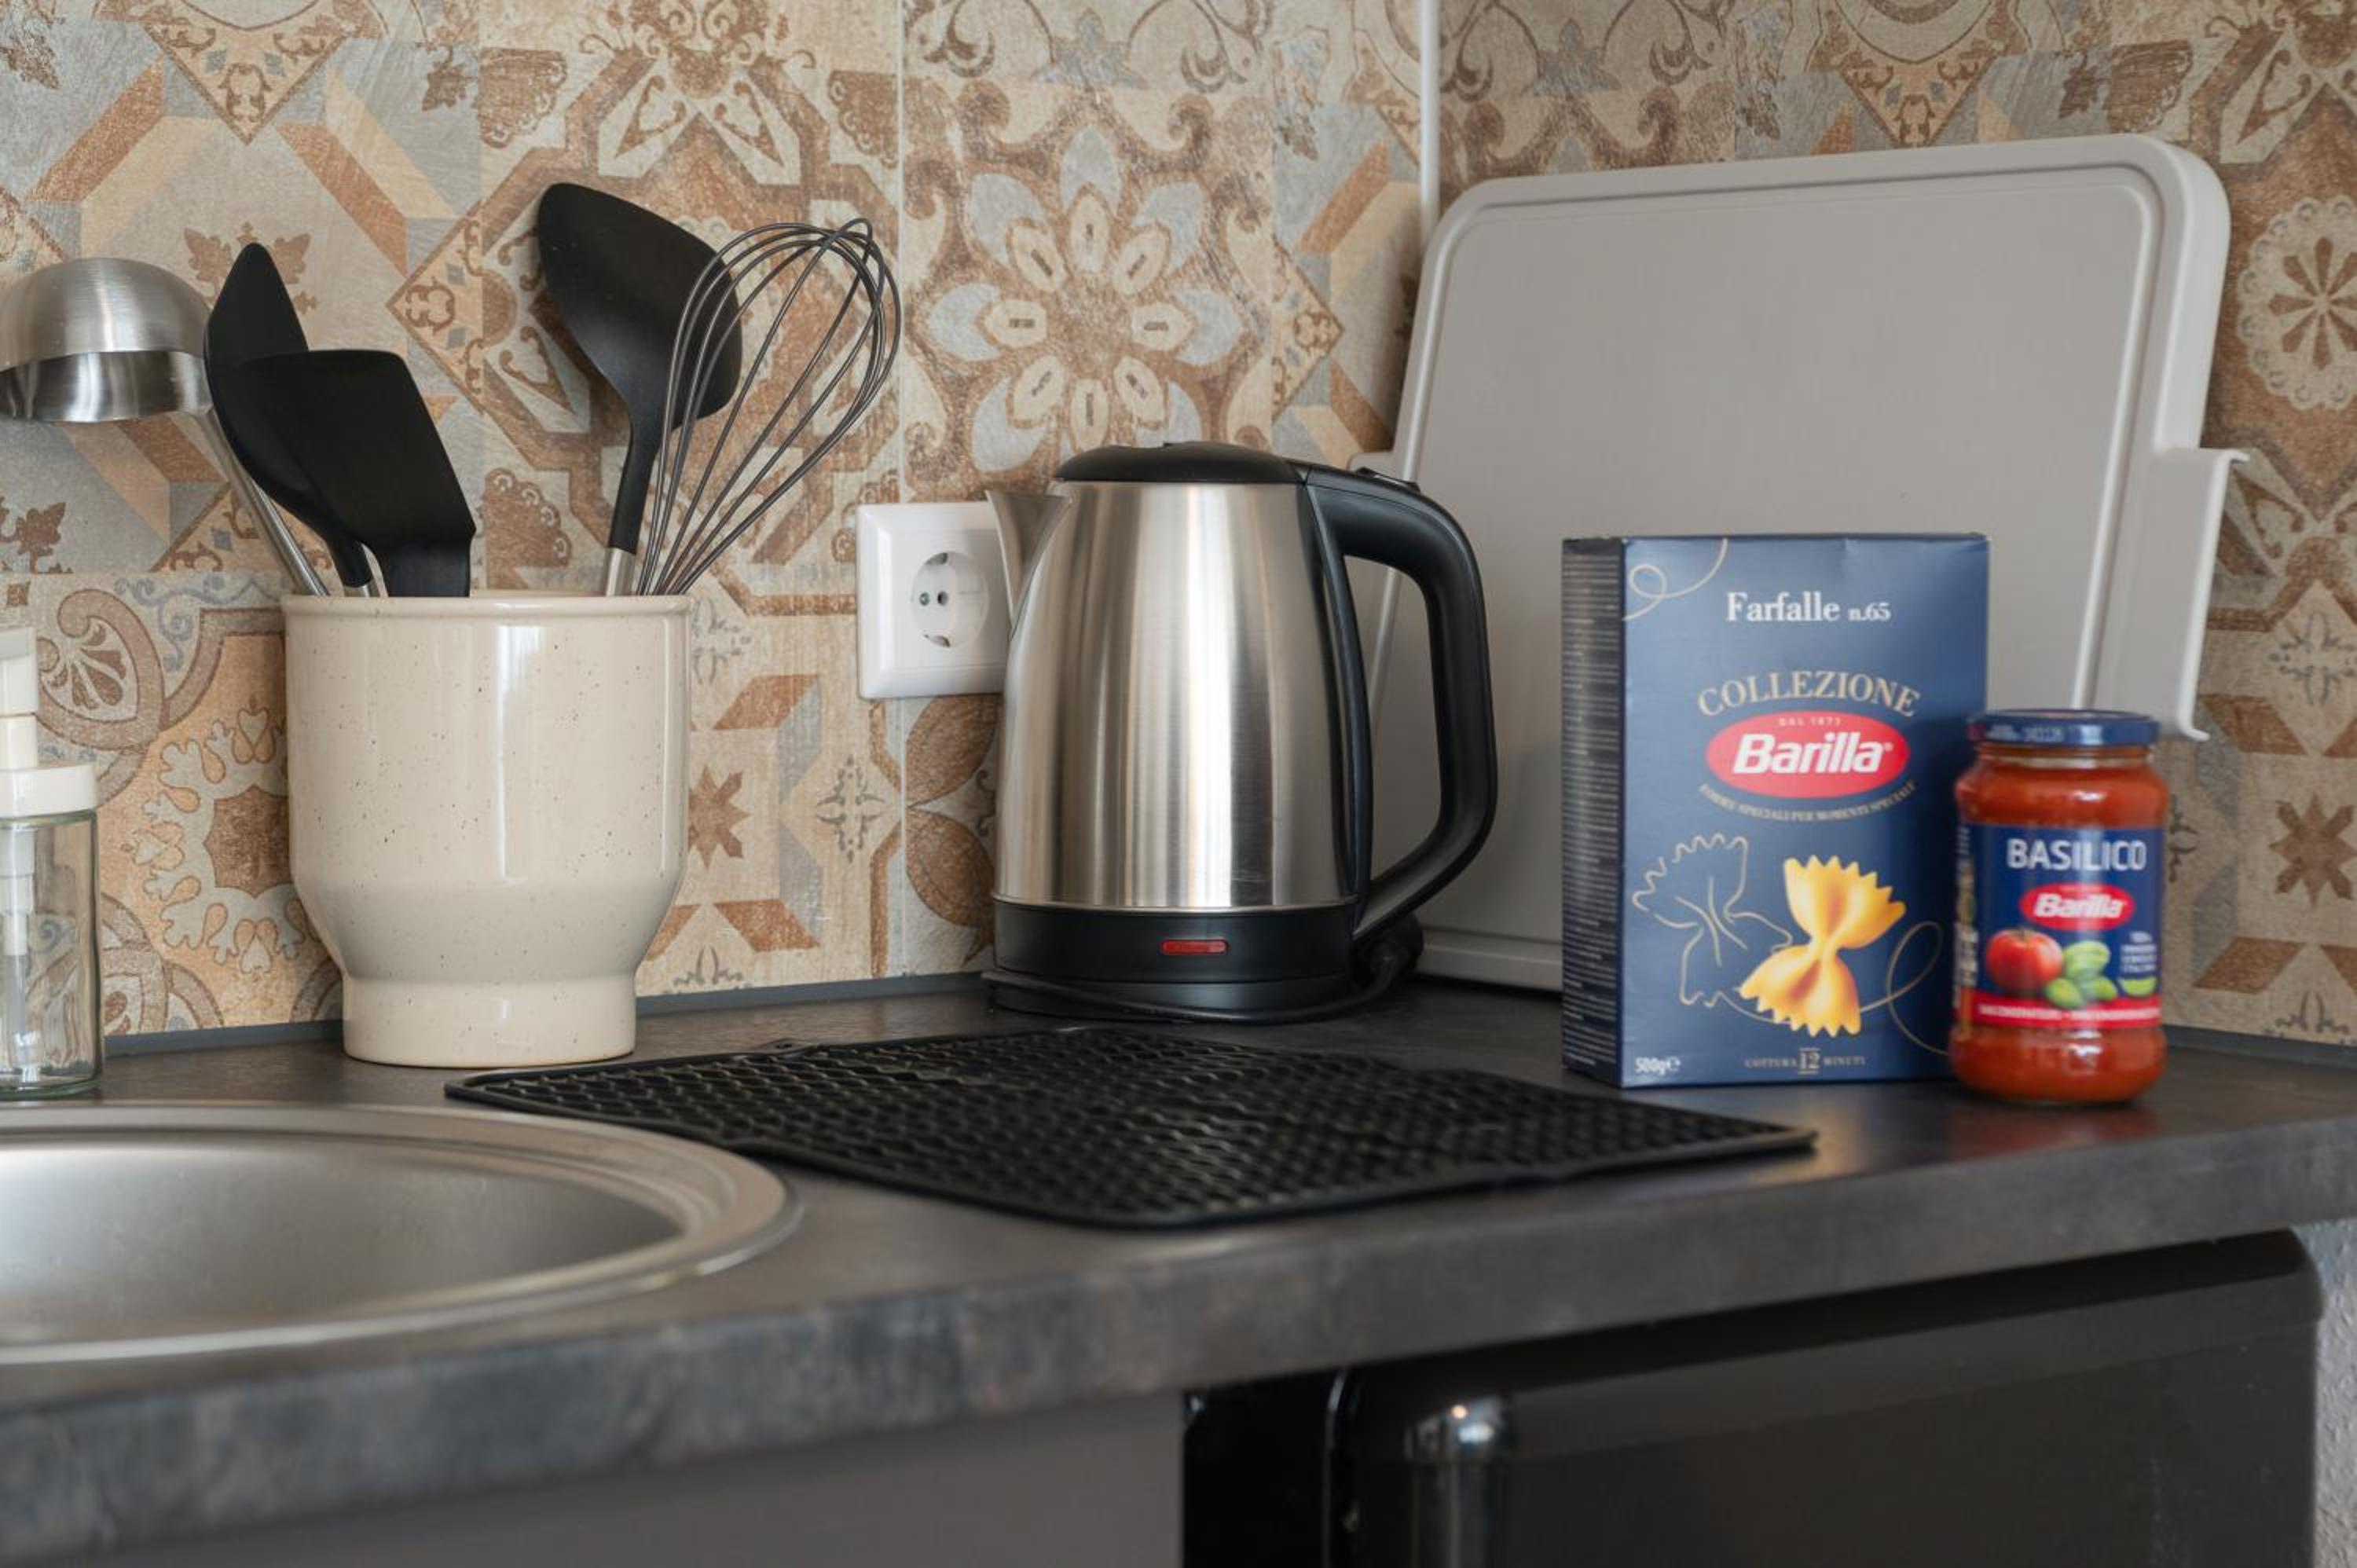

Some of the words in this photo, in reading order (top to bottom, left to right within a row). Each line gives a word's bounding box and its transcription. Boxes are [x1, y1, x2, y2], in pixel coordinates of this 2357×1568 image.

[1725, 591, 1841, 622] Farfalle
[1697, 670, 1920, 716] COLLEZIONE
[1732, 731, 1886, 775] Barilla
[2007, 837, 2147, 871] BASILICO
[2033, 892, 2125, 918] Barilla
[1799, 1052, 1821, 1069] 12
